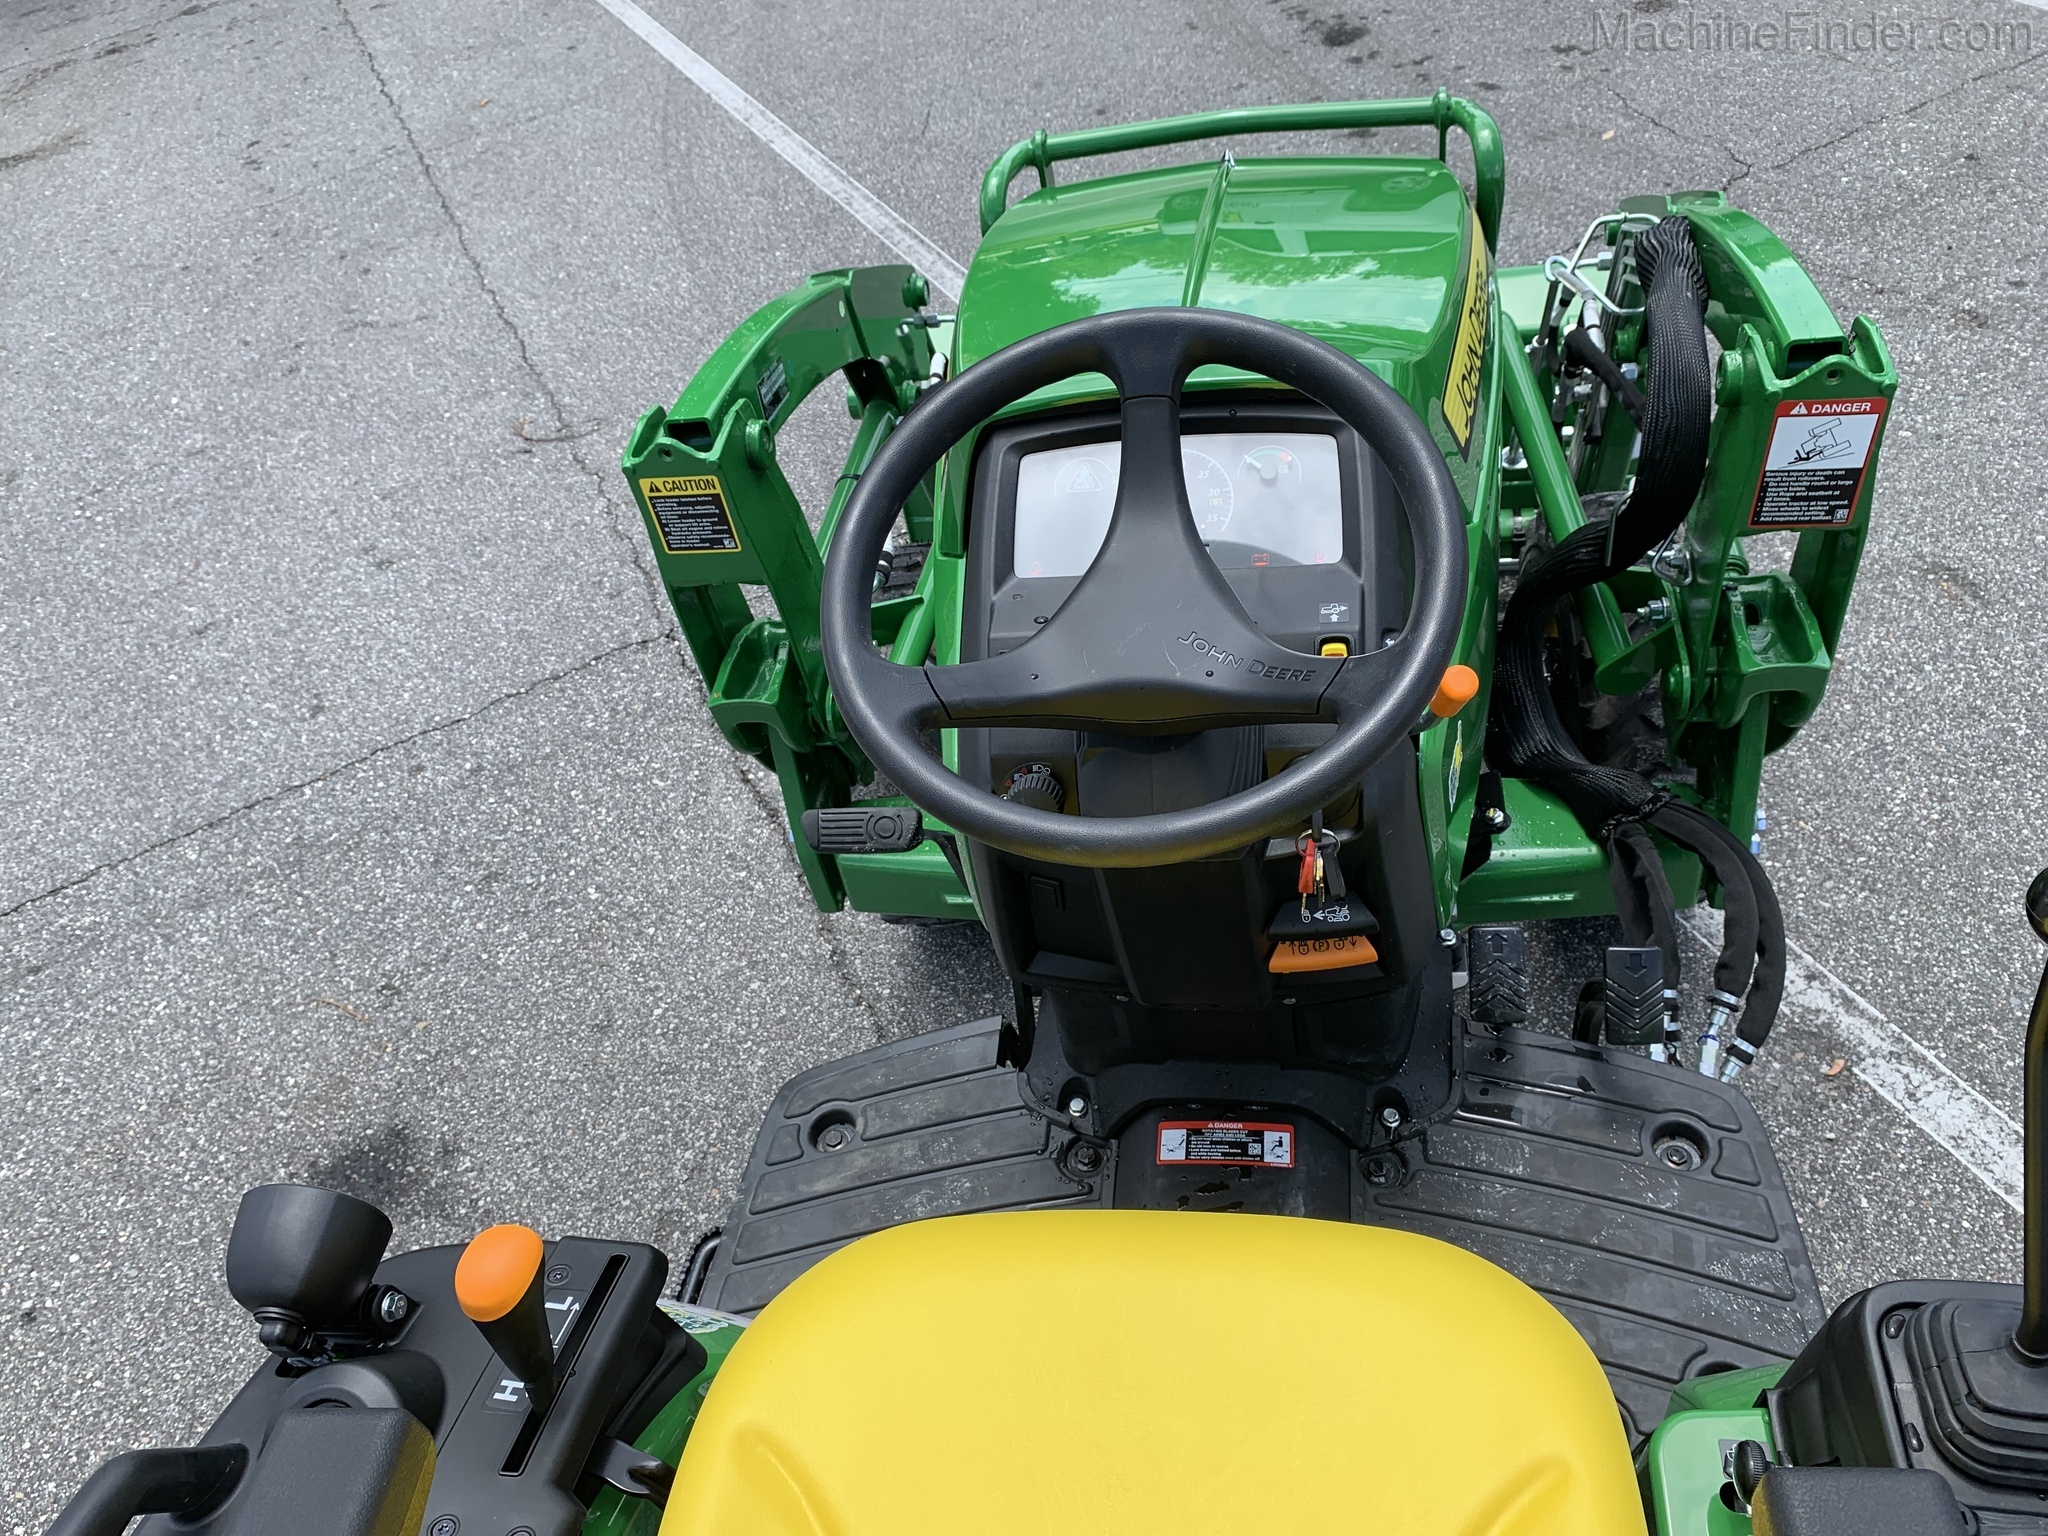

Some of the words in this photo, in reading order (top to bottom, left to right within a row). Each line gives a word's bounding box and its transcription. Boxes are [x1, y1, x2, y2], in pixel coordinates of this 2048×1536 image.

[1456, 340, 1482, 427] JOHN
[1469, 259, 1488, 341] DEERE
[1812, 403, 1871, 413] DANGER
[1198, 471, 1209, 479] 25
[663, 478, 716, 492] CAUTION
[1208, 488, 1220, 497] 30
[1206, 514, 1218, 522] 35
[1177, 631, 1243, 670] JOHN
[1244, 659, 1316, 682] DEERE
[544, 1296, 574, 1310] L
[492, 1379, 525, 1402] H
